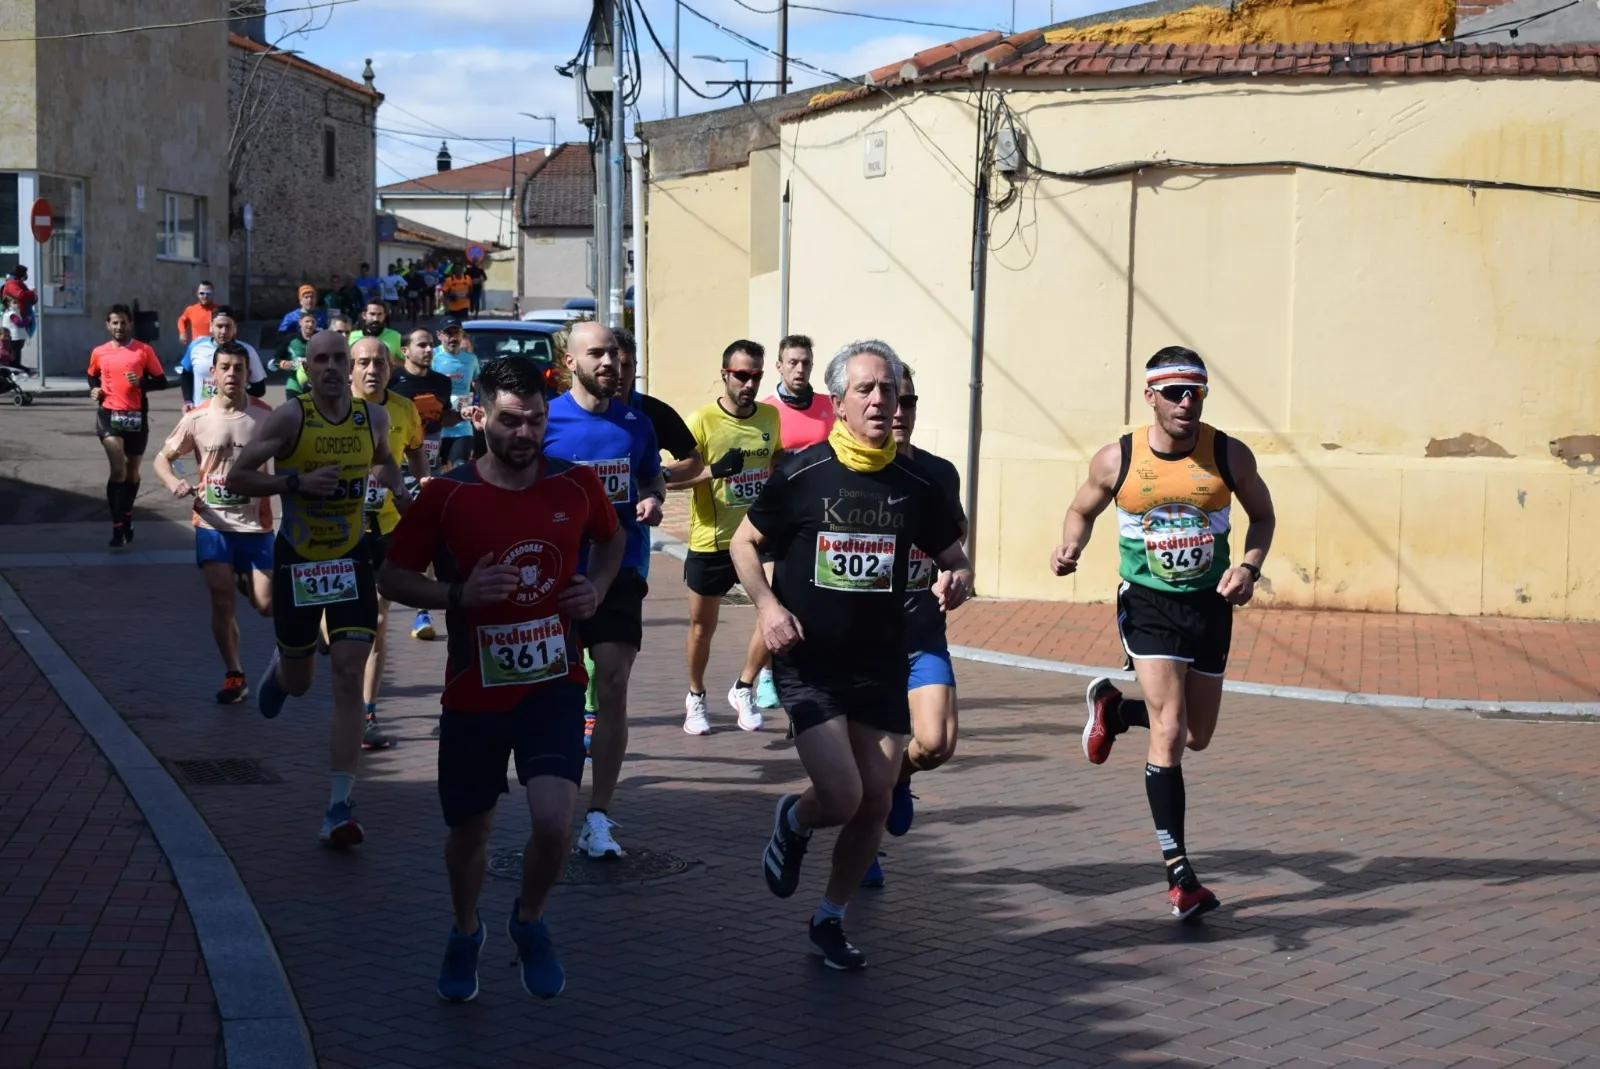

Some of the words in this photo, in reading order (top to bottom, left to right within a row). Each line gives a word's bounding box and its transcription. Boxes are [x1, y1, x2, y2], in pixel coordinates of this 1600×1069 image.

[315, 436, 362, 454] CORDERO
[734, 481, 764, 498] 358
[821, 497, 904, 528] Kaoba
[1149, 516, 1203, 529] ALCER
[818, 535, 894, 555] bedunia
[1146, 531, 1214, 552] bedunia
[831, 553, 880, 577] 302
[1161, 547, 1203, 570] 349
[293, 562, 354, 579] bedunia
[305, 575, 345, 595] 314
[516, 592, 527, 602] DE
[528, 592, 539, 602] LA
[538, 578, 556, 594] VIDA
[480, 621, 563, 647] bedunia
[497, 641, 549, 671] 361
